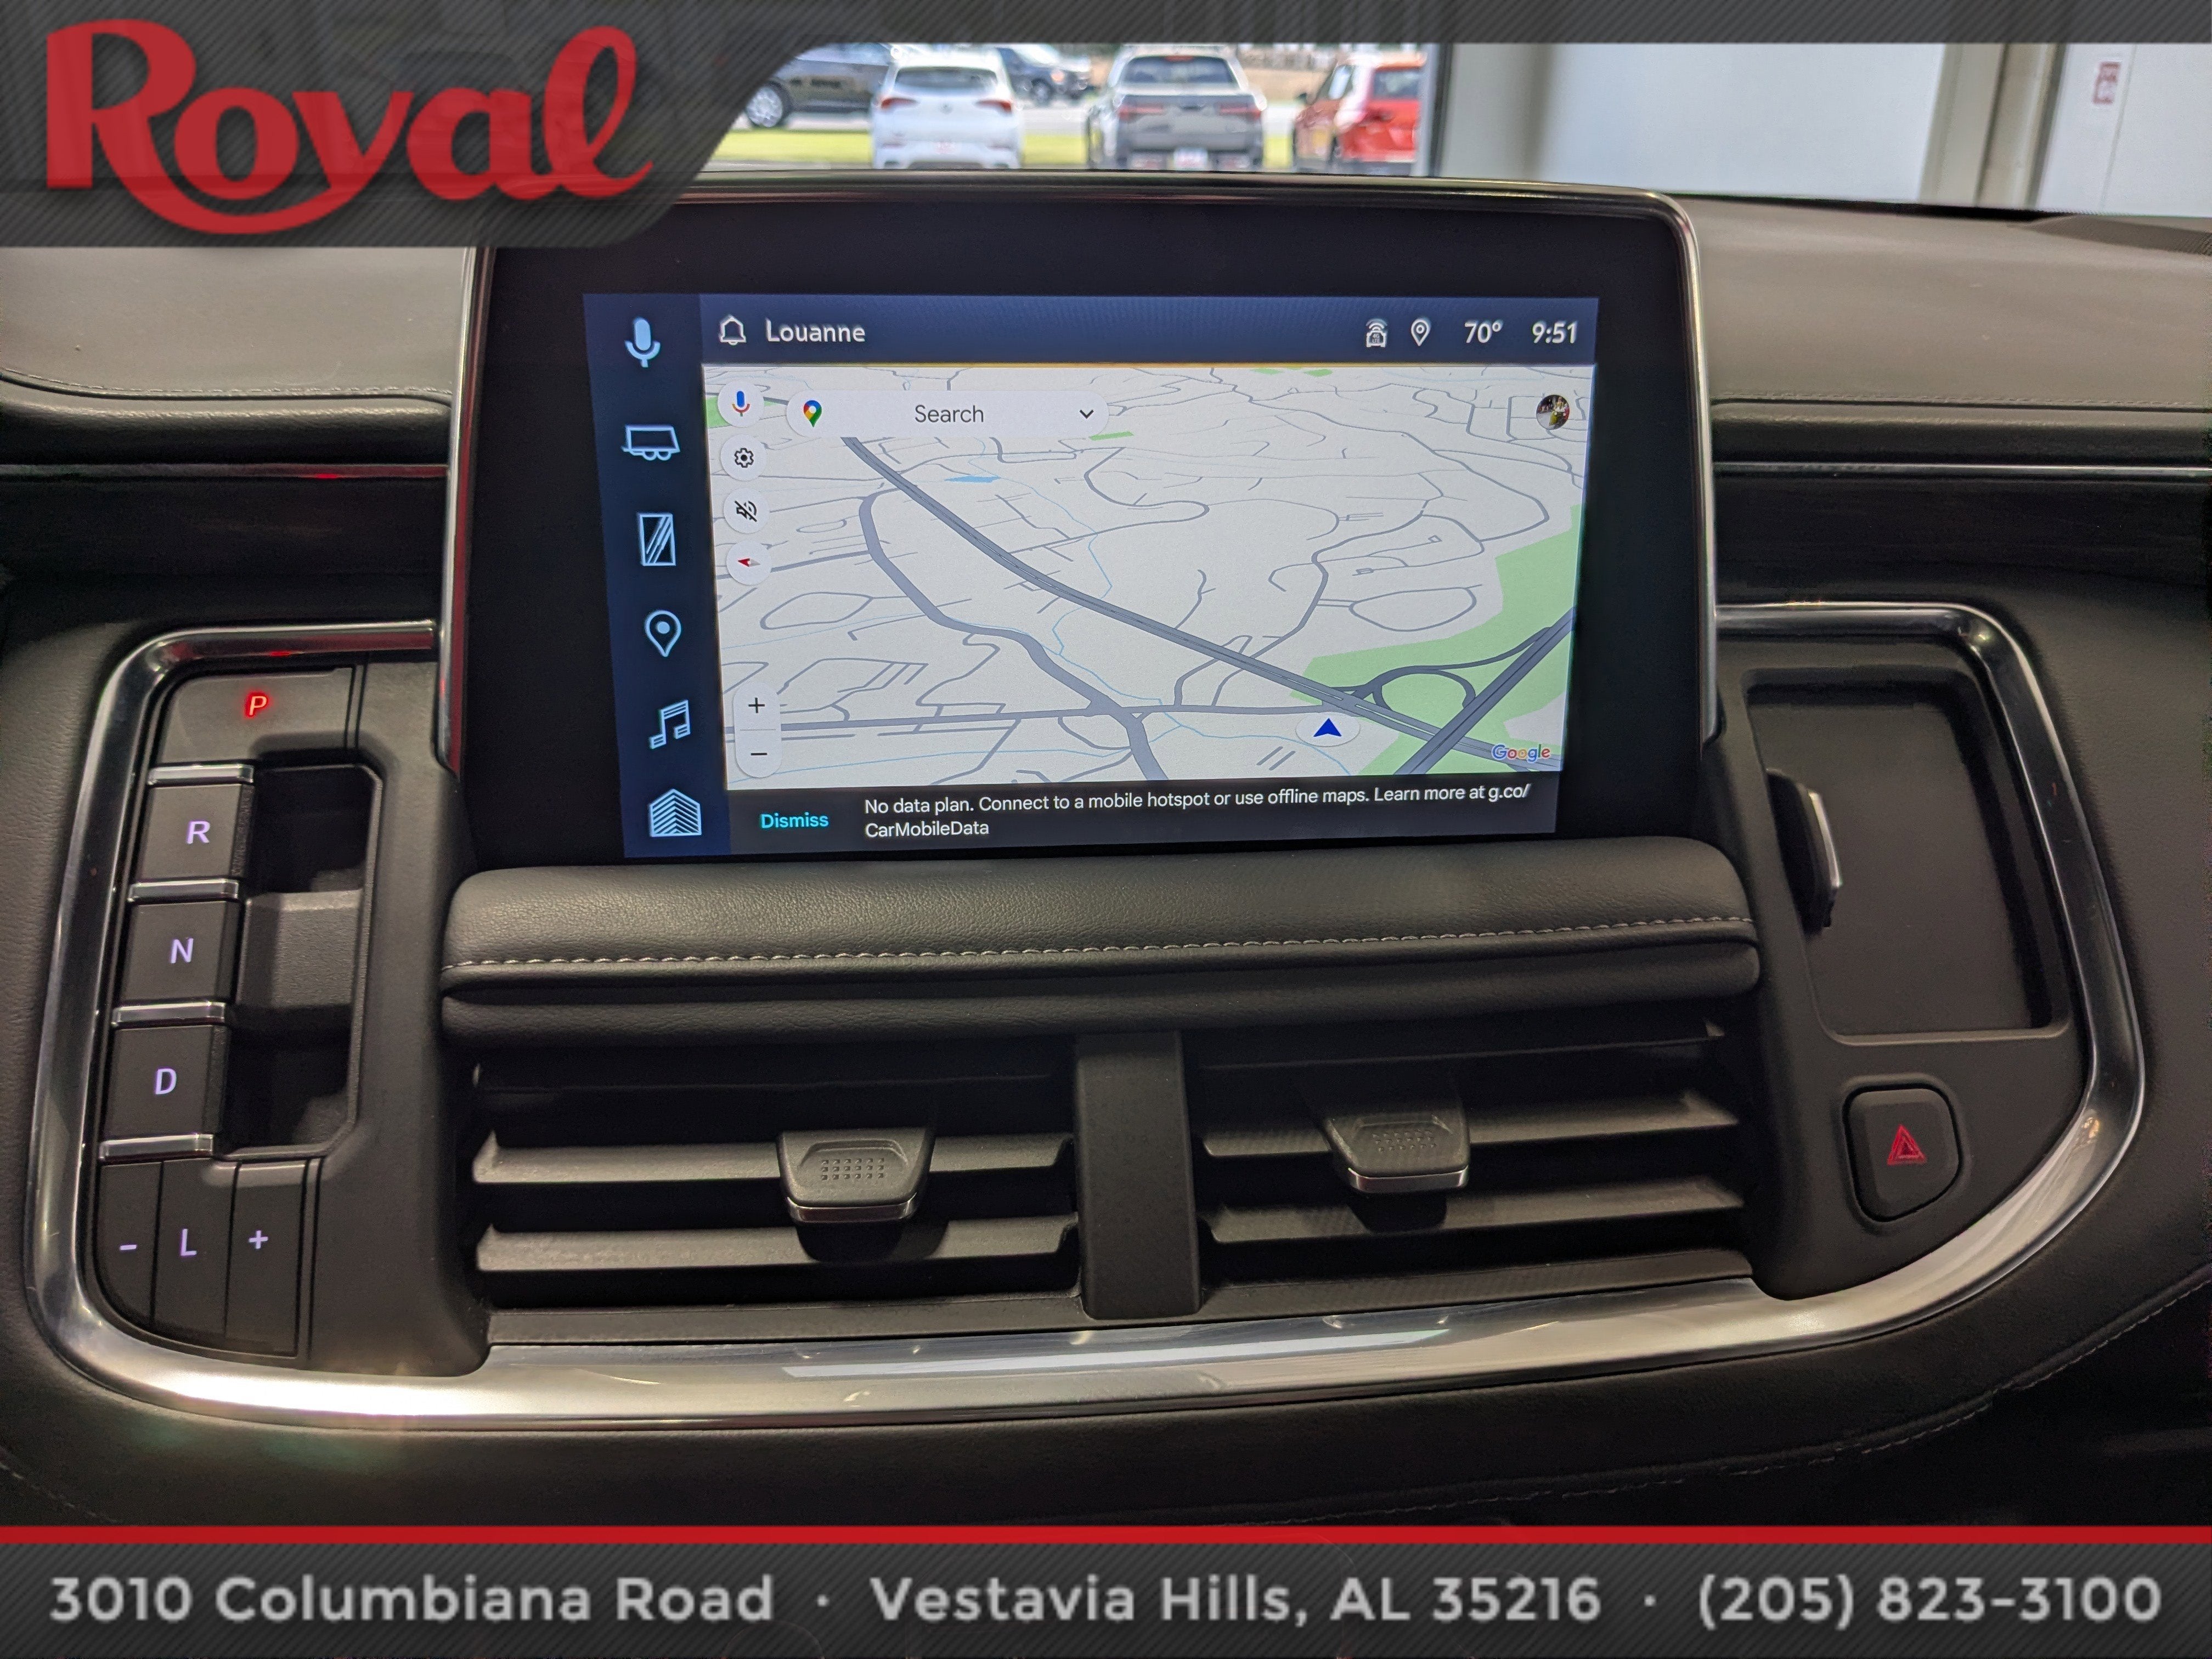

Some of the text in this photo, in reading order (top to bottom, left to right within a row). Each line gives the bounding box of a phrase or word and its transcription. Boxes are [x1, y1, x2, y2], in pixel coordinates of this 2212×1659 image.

[766, 318, 865, 342] Louanne
[1464, 320, 1577, 344] 70° 9:51
[915, 404, 984, 423] Search
[246, 694, 267, 717] P
[1492, 743, 1551, 763] Google
[865, 783, 1532, 816] No data plan. Connect to a mobile hotspot or use offline maps. Learn more at g.co/
[186, 820, 211, 844] R
[760, 812, 830, 829] Dismiss
[865, 820, 990, 838] CarMobileData
[170, 938, 194, 964] N
[155, 1067, 177, 1095] D
[180, 1228, 198, 1256] L
